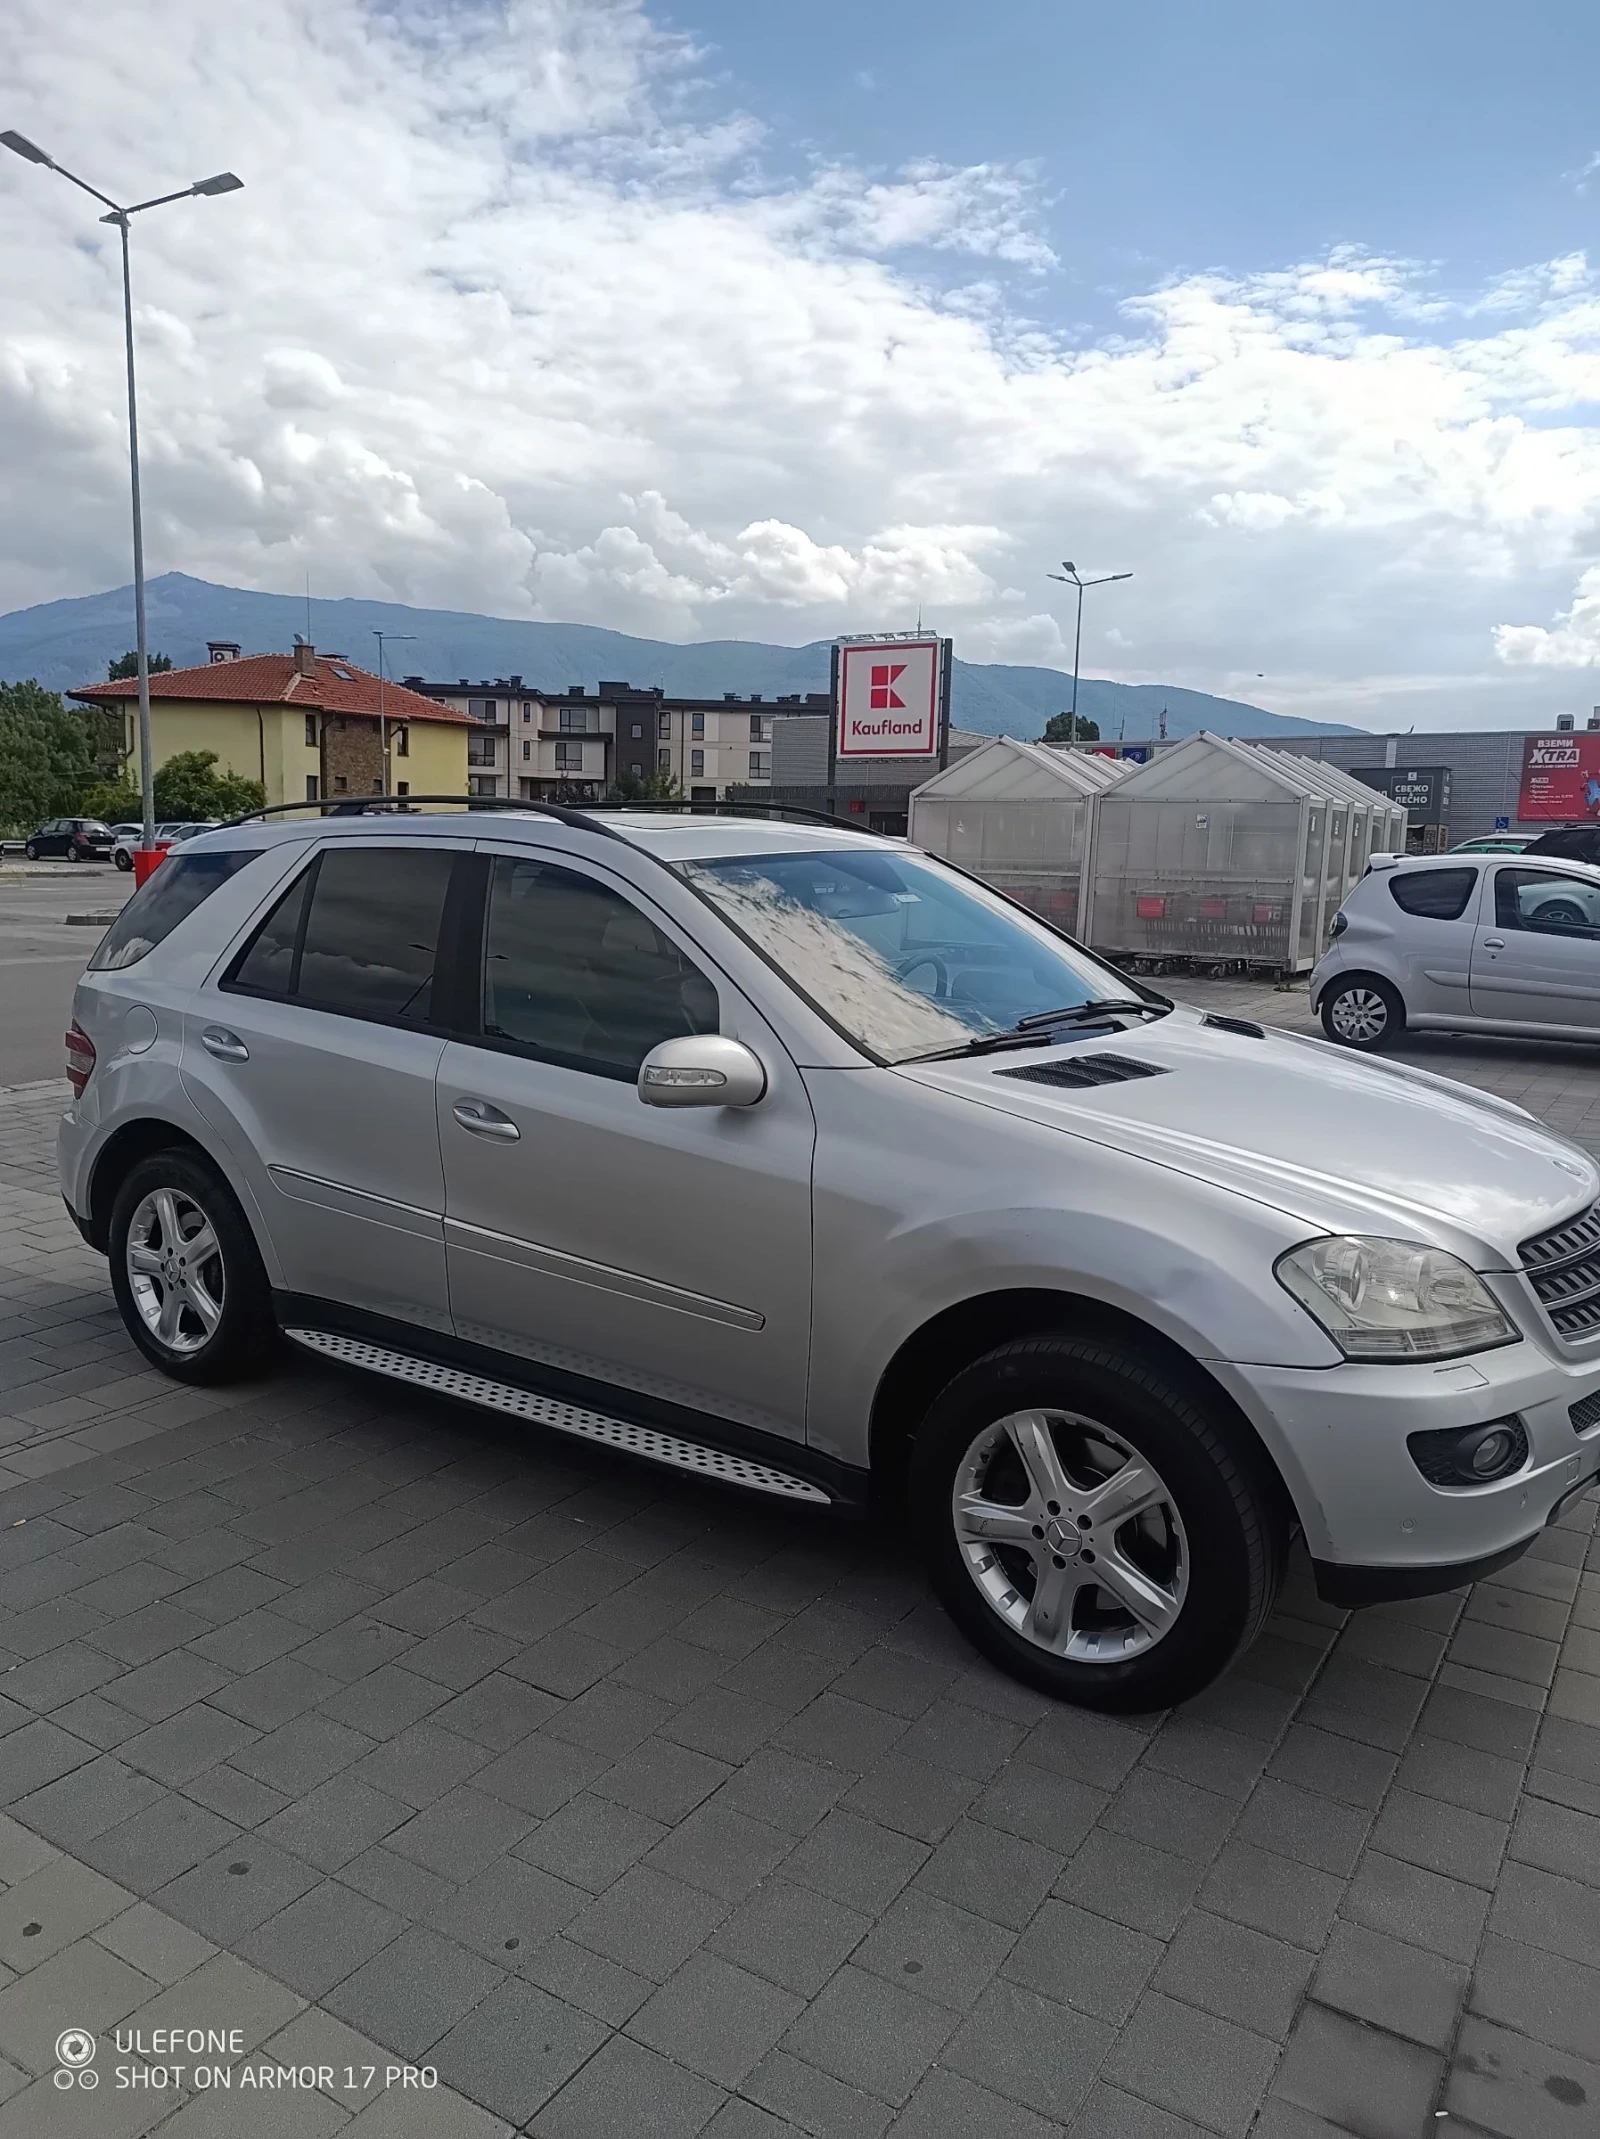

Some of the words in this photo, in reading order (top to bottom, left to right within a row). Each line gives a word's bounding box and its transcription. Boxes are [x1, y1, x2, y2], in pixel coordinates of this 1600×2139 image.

[852, 718, 922, 735] Kaufland
[1537, 739, 1574, 748] ВЗЕМИ
[1528, 748, 1581, 764] XTRA
[1394, 784, 1429, 793] СВЕЖО
[1395, 796, 1428, 804] ЛЕСНО
